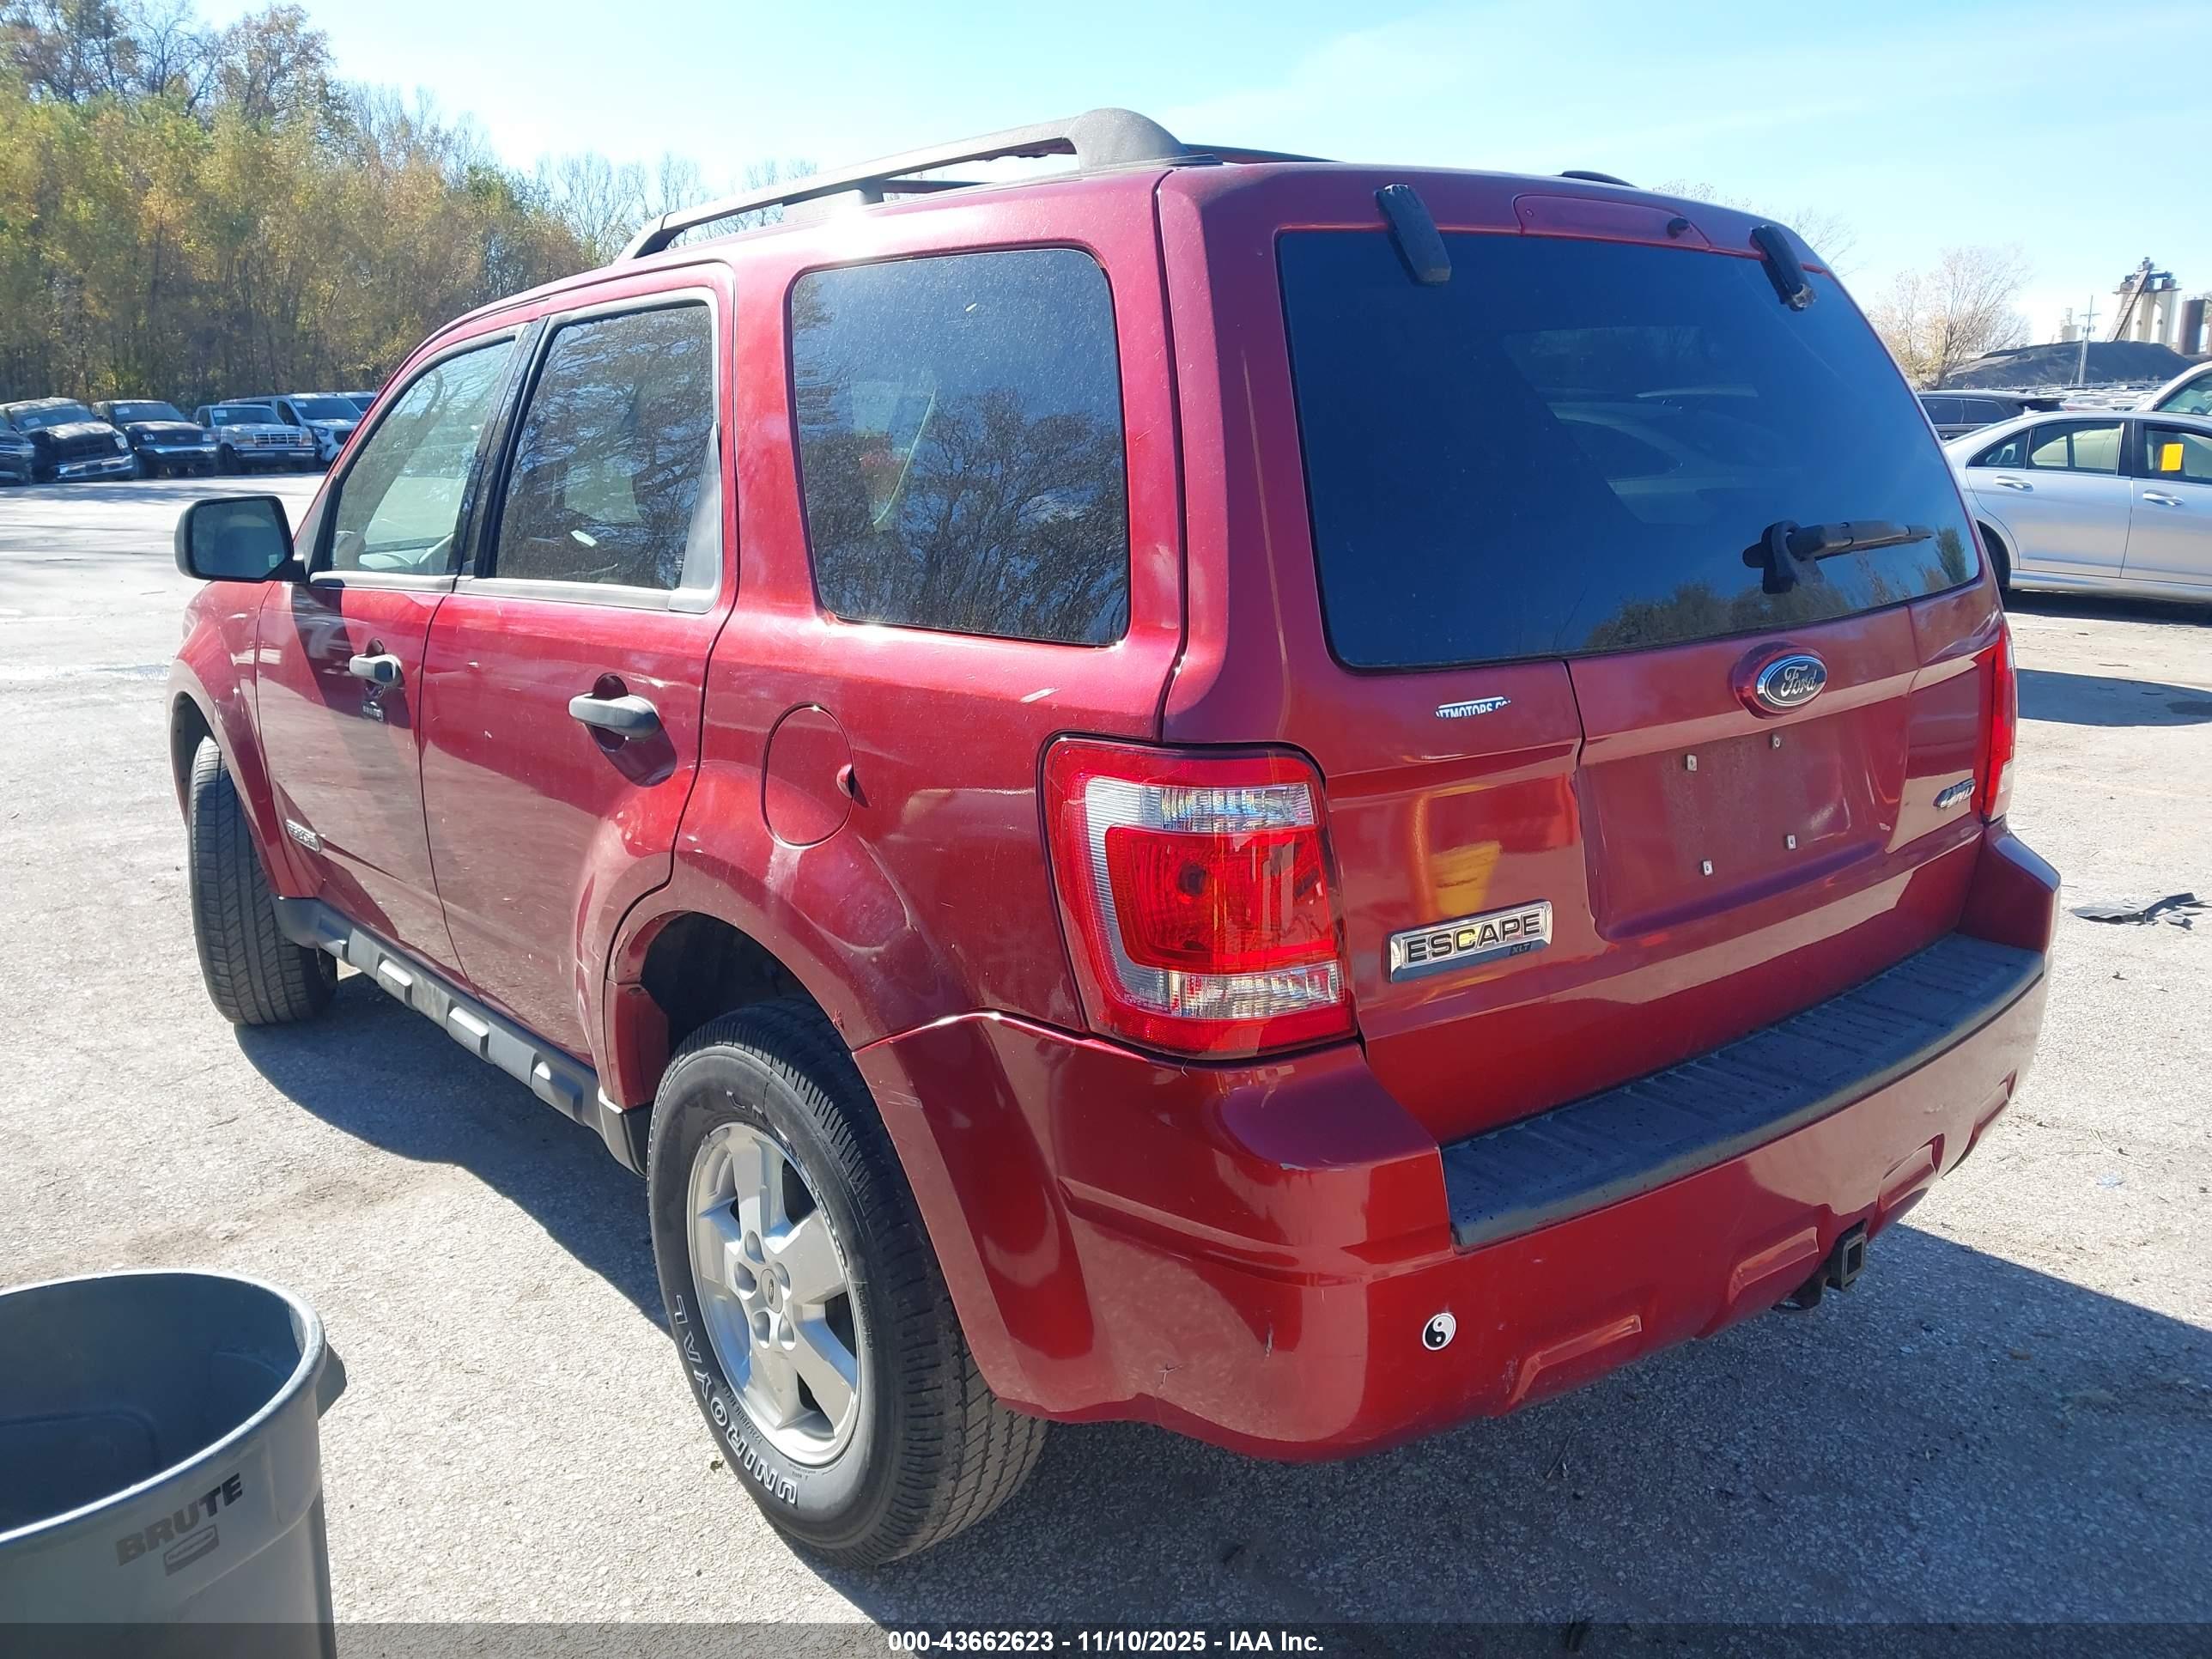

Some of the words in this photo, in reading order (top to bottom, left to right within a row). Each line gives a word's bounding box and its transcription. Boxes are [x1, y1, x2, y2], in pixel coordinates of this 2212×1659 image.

[1780, 665, 1818, 696] Ford
[1407, 912, 1540, 963] ESCAPE
[1511, 943, 1531, 954] XLT
[673, 1294, 799, 1504] UNIROYAL
[116, 1473, 243, 1566] BRUTE
